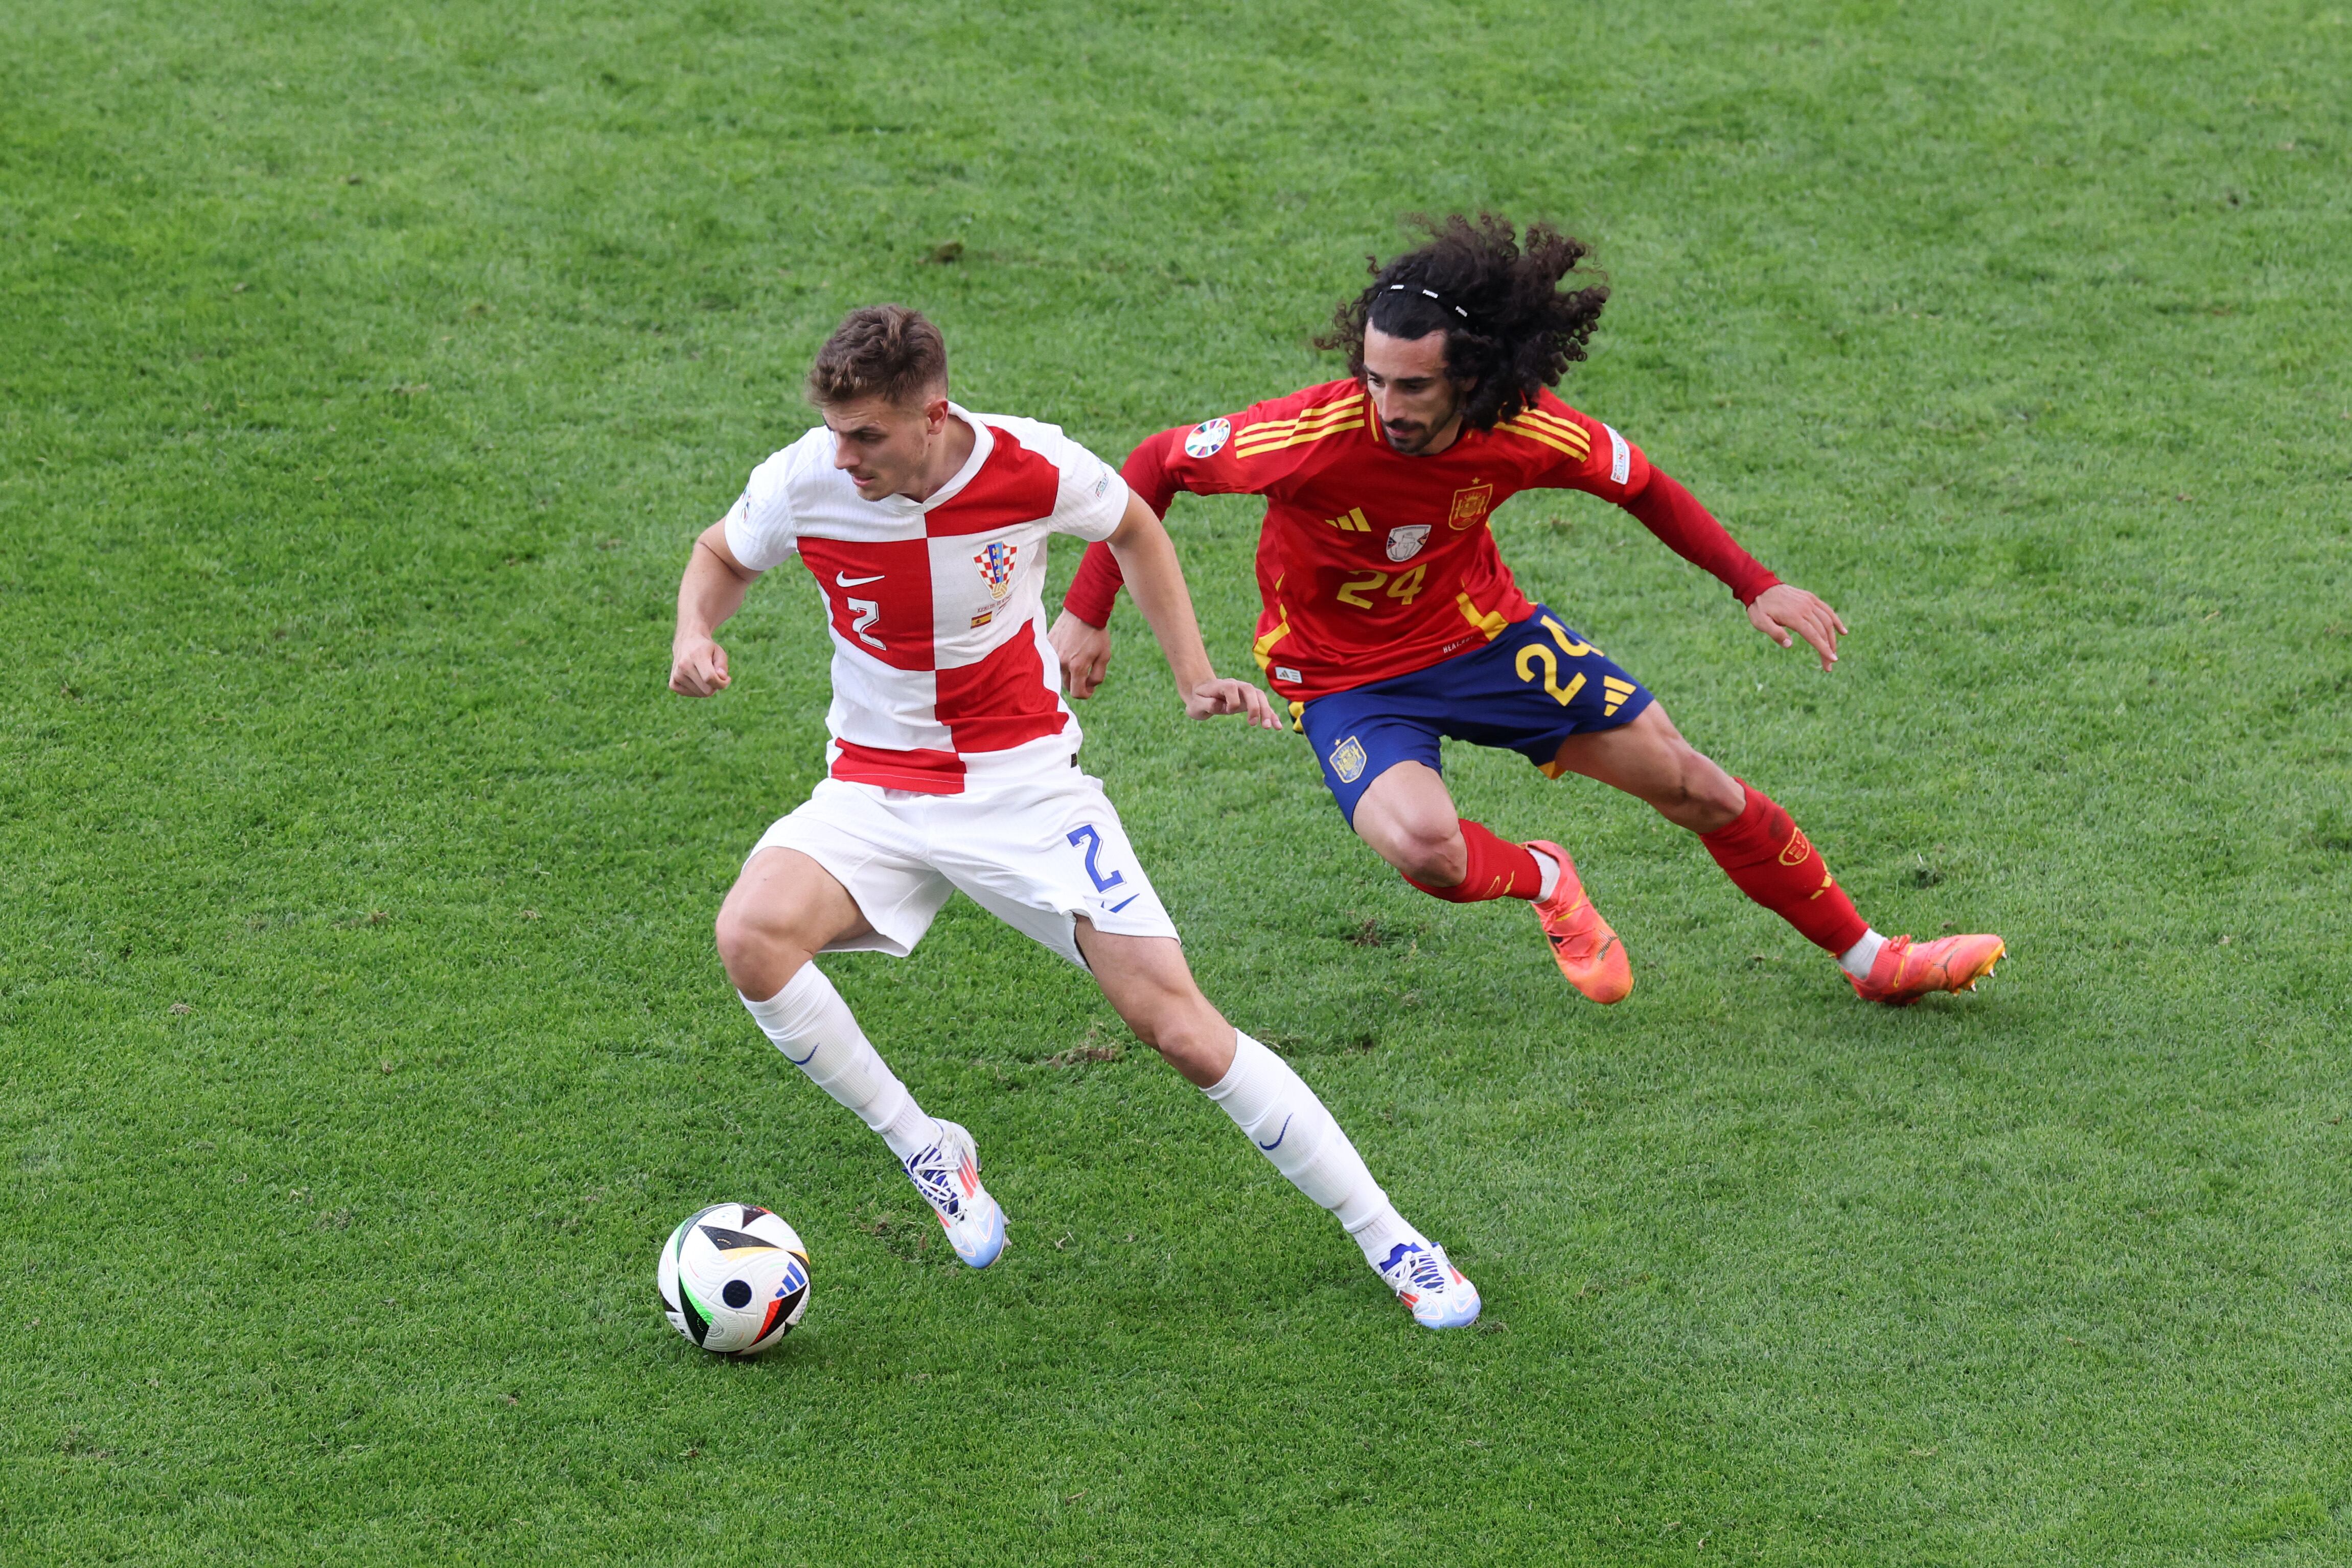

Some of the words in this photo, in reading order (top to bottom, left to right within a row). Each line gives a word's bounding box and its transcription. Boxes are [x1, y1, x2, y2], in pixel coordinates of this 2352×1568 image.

[992, 547, 1002, 578] HNS
[1336, 563, 1427, 610] 24
[847, 596, 887, 651] 2
[1515, 614, 1605, 707] 24
[1066, 824, 1127, 894] 2
